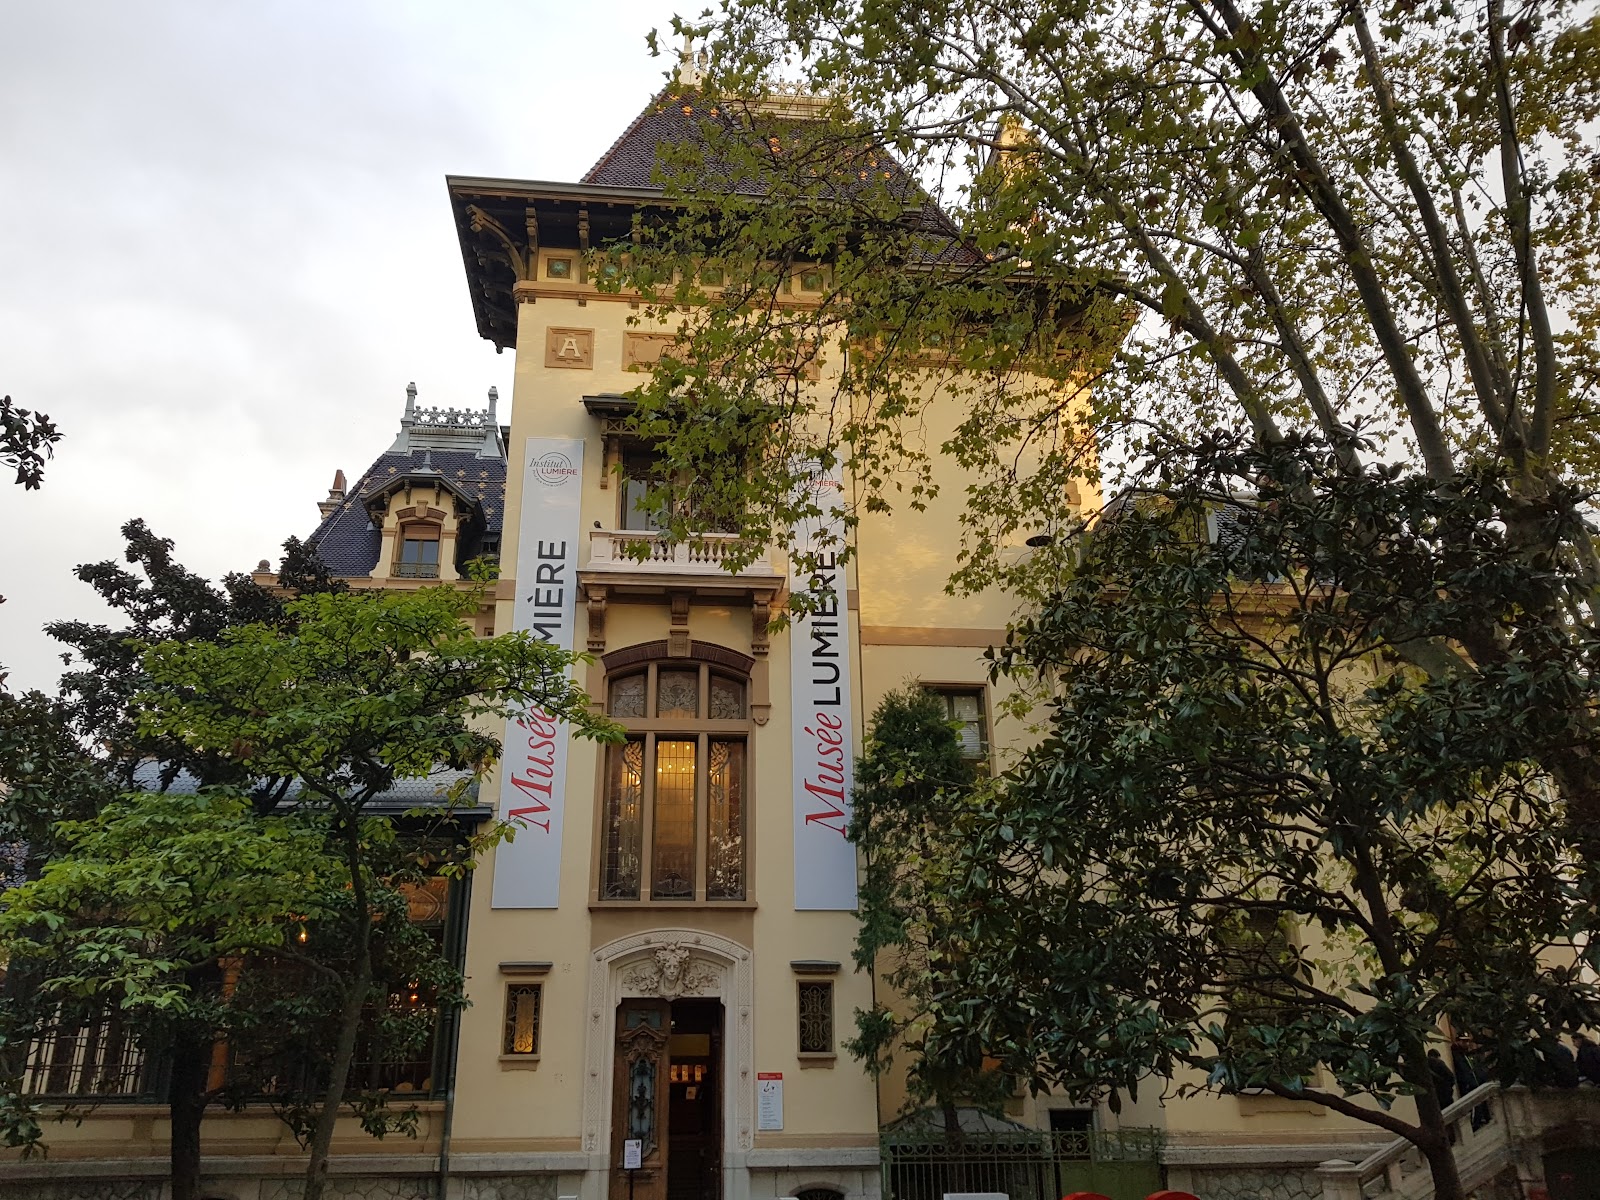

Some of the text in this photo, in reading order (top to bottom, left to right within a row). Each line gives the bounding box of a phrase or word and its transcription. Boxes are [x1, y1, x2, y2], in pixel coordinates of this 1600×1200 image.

[558, 337, 581, 358] A
[529, 457, 564, 468] Institut
[541, 467, 578, 476] LUMIÈRE
[526, 540, 567, 692] MIÈRE
[508, 704, 557, 835] Musée
[803, 712, 847, 839] Musée
